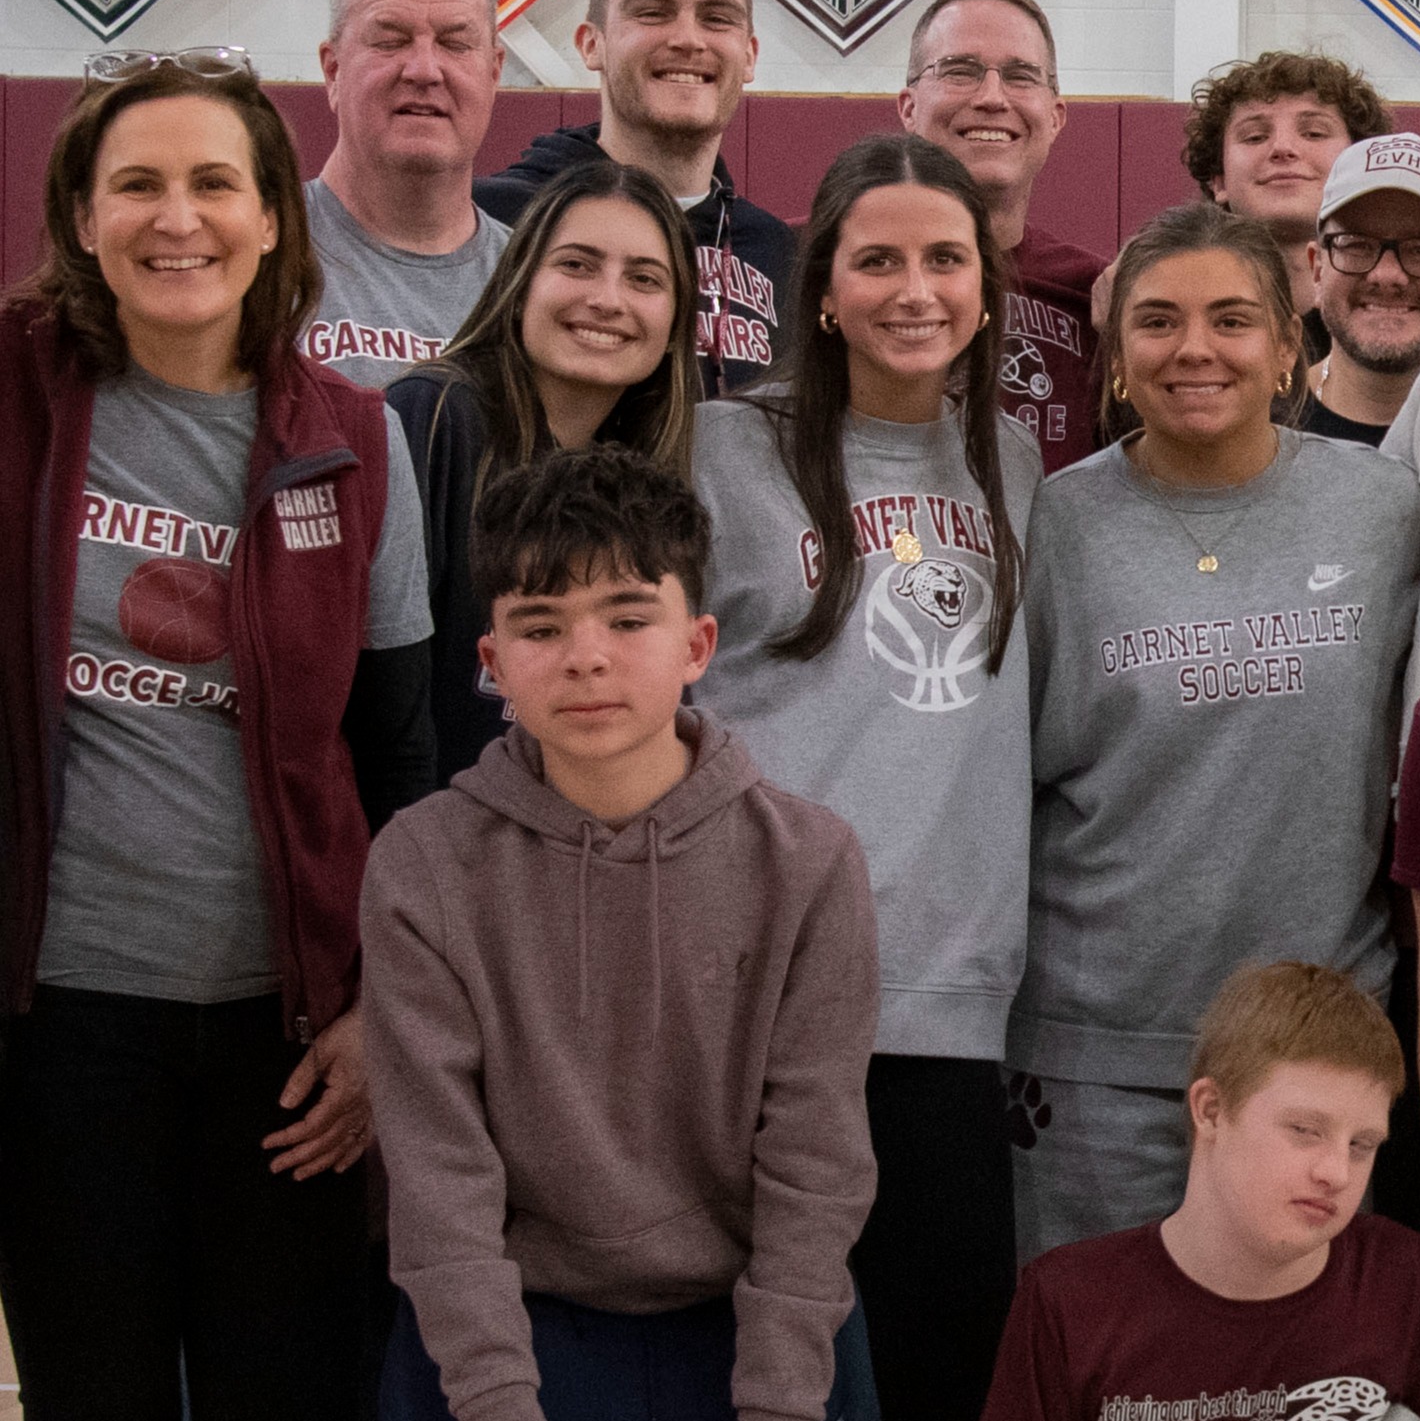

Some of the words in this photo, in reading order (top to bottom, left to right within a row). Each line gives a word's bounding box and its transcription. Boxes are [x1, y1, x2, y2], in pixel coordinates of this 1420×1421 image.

[307, 319, 446, 364] GARNET
[1003, 293, 1081, 357] ALLEY
[79, 492, 193, 556] RNET
[274, 483, 337, 517] GARNET
[279, 516, 342, 551] VALLEY
[1314, 564, 1344, 579] NIKE
[1101, 619, 1235, 676] GARNET
[1245, 605, 1364, 652] VALLEY
[66, 653, 187, 707] OCCE
[1179, 654, 1304, 706] SOCCER
[1200, 1392, 1231, 1419] best
